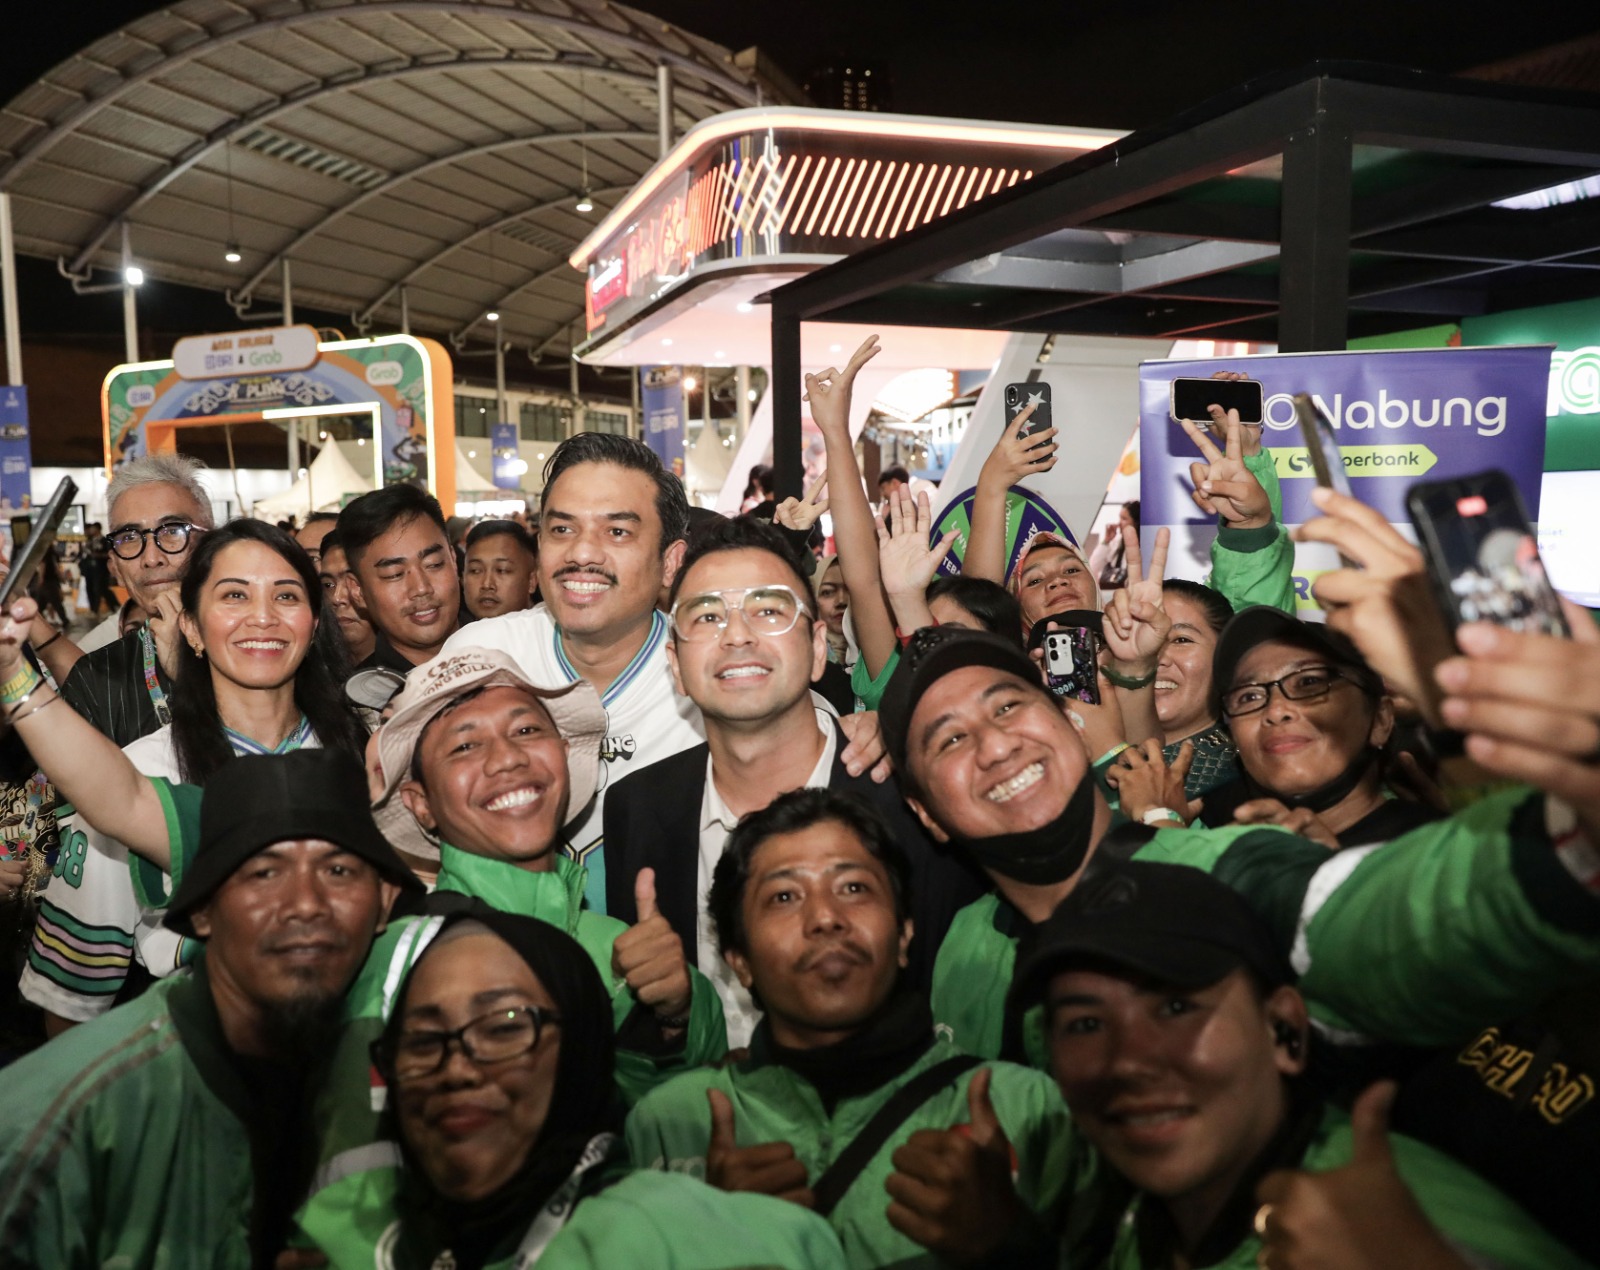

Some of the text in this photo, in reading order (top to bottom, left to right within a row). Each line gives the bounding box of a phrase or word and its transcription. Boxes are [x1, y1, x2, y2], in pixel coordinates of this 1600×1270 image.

[249, 349, 283, 366] Grab
[1311, 389, 1507, 437] Nabung
[1341, 451, 1420, 467] perbank
